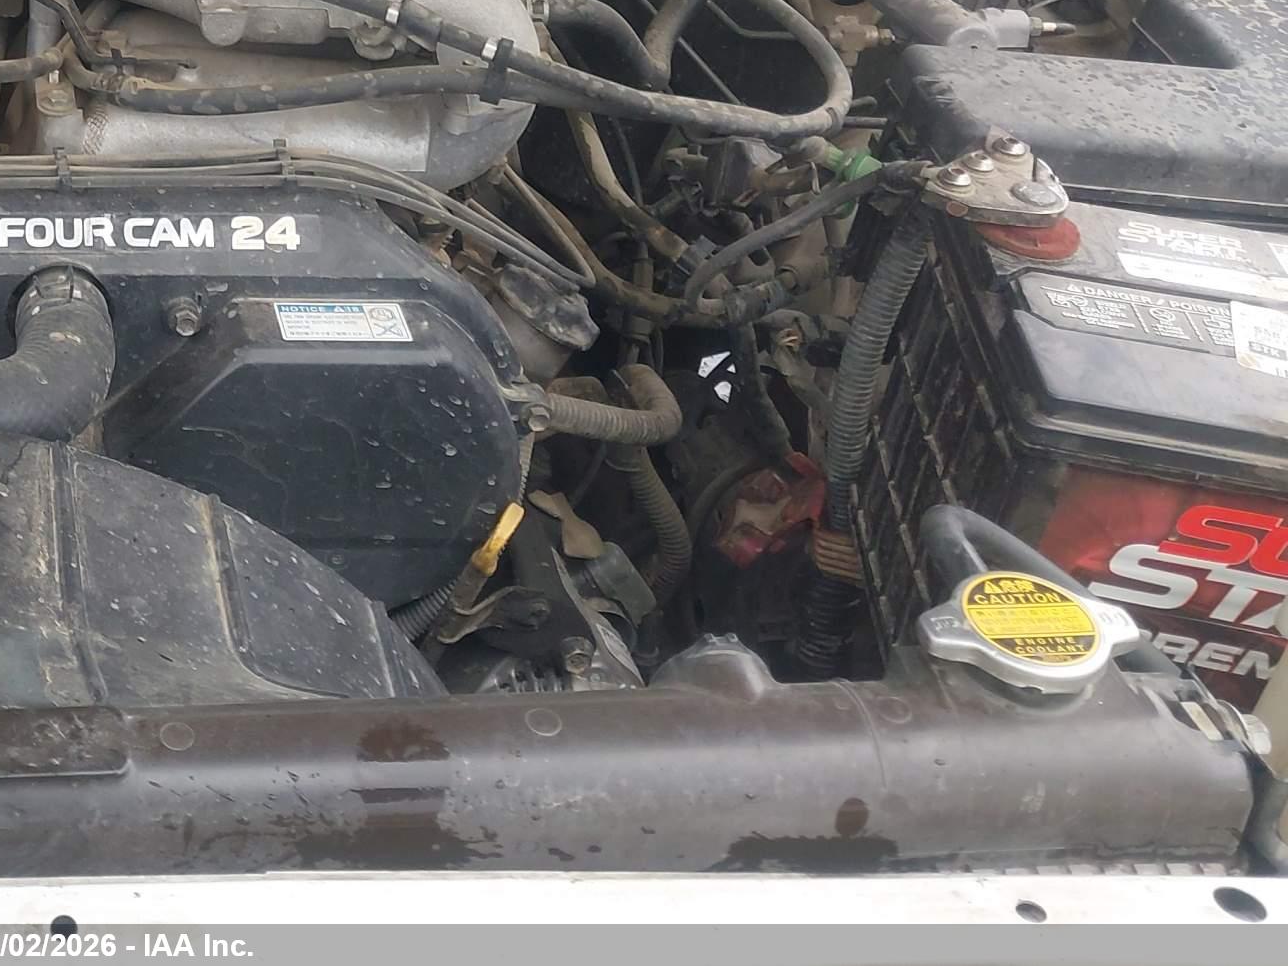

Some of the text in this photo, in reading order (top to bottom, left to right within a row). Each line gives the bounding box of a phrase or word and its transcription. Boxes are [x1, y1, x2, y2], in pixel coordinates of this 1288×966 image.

[124, 217, 215, 248] CAM
[231, 216, 300, 250] 24
[1083, 287, 1152, 305] DANGER
[1169, 301, 1231, 316] POISON
[281, 305, 327, 313] NOTICE
[973, 593, 1062, 605] CAUTION
[1015, 637, 1076, 645] ENGINE
[1015, 645, 1086, 653] COOLANT
